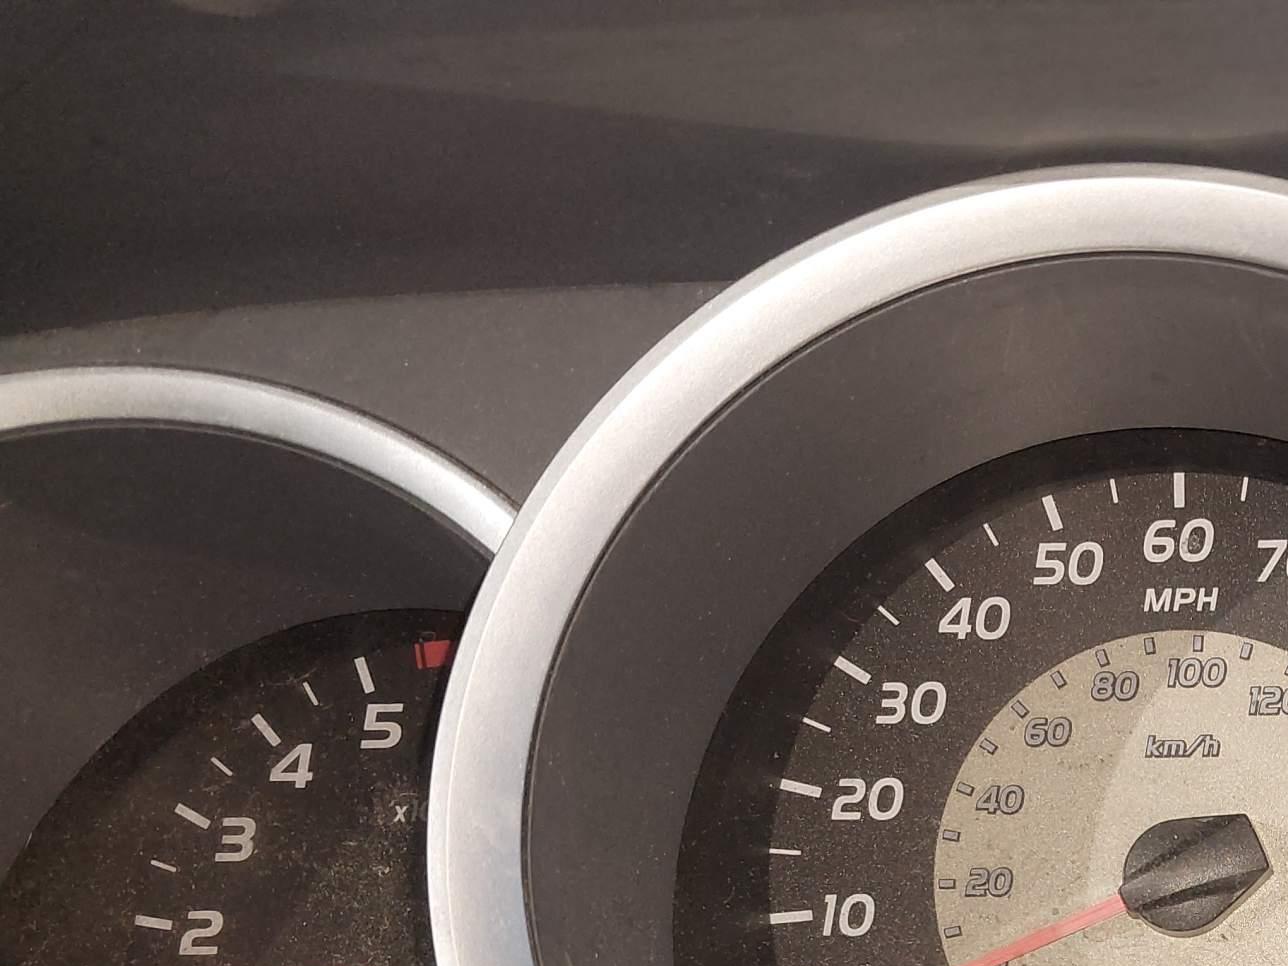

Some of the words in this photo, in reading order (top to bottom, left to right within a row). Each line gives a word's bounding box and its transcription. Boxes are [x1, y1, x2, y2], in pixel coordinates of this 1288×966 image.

[1143, 519, 1214, 562] 60
[1033, 542, 1104, 585] 50
[939, 597, 1010, 640] 40
[1144, 588, 1218, 612] MPH
[1091, 671, 1139, 700] 80
[1167, 658, 1227, 688] 100
[876, 682, 946, 724] 30
[360, 703, 403, 749] 5
[1024, 717, 1072, 747] 60
[1145, 735, 1220, 758] km/h
[270, 743, 313, 788] 4
[831, 778, 903, 821] 20
[976, 785, 1024, 814] 40
[214, 817, 256, 862] 3
[965, 867, 1013, 897] 20
[179, 911, 224, 955] 2
[823, 893, 875, 937] 10
